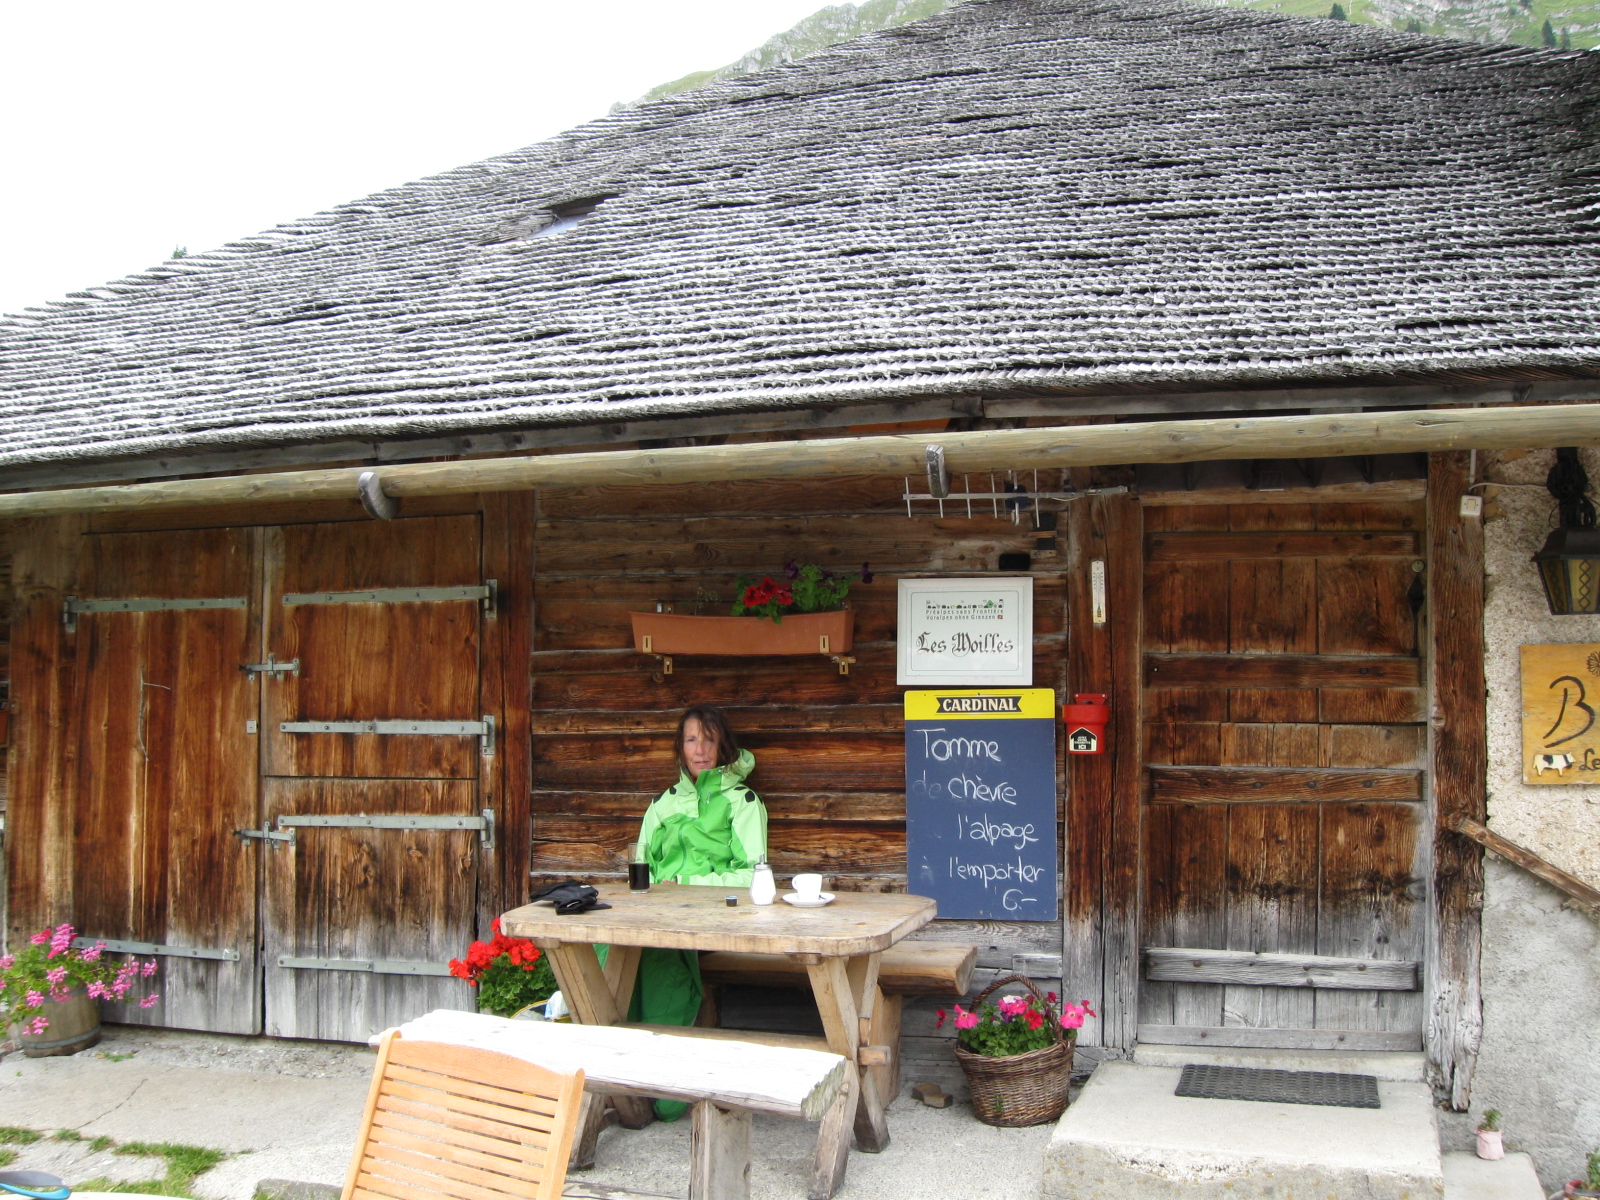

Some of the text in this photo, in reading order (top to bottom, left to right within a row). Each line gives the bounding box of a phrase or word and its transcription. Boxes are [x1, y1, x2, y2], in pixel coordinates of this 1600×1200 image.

[916, 631, 1014, 657] Les Moilles
[942, 697, 1018, 712] CARDINAL
[913, 728, 1001, 762] Tomme
[912, 770, 942, 799] de
[958, 813, 1039, 850] l'alpage
[949, 856, 1046, 888] l'emporter
